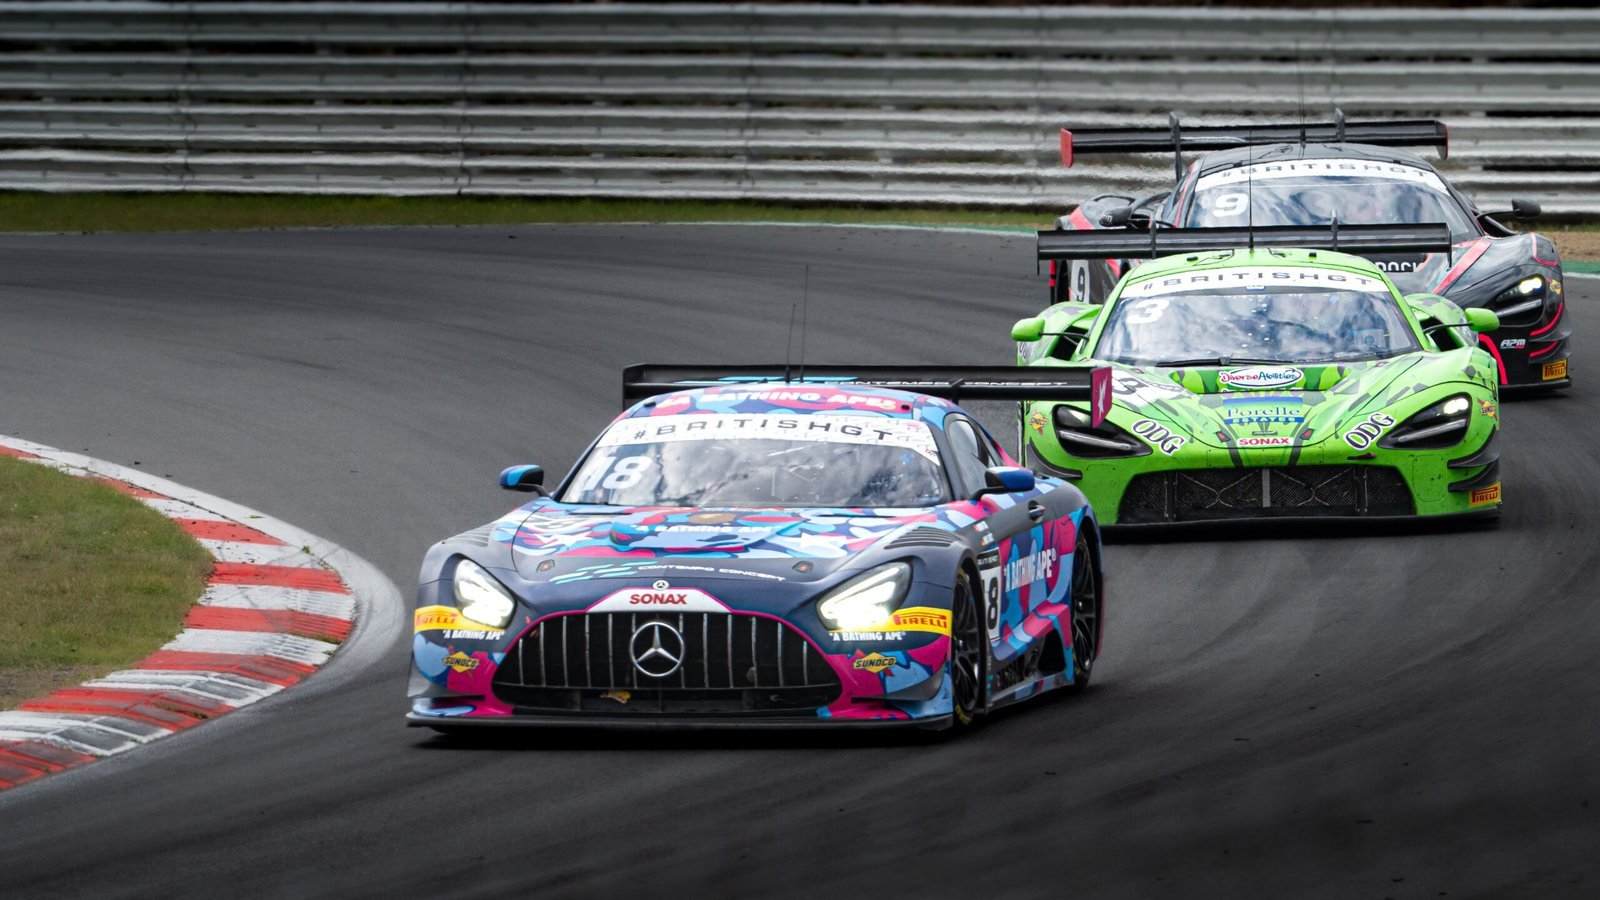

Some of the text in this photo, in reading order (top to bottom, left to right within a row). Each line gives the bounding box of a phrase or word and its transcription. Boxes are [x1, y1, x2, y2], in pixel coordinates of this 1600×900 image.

[1222, 162, 1428, 178] #BRITISHGT
[1212, 193, 1248, 217] 9
[1077, 266, 1086, 302] 9
[1143, 272, 1372, 291] #BRITISHGT
[1126, 299, 1169, 324] 3
[1226, 406, 1301, 418] Porelle
[633, 418, 893, 441] #BRITISHGT
[1133, 420, 1185, 454] ODG
[1344, 413, 1395, 449] ODG
[1238, 437, 1290, 446] SONAX
[580, 455, 653, 492] 18
[638, 564, 786, 582] CONTEMPO CONCEPT
[629, 593, 688, 606] SONAX
[980, 576, 999, 631] 8
[415, 611, 458, 628] PIRELLI
[893, 612, 948, 629] PIRELLI
[451, 630, 485, 640] BATHING
[842, 631, 882, 642] BATHING
[444, 655, 479, 669] SUNOCO
[854, 657, 897, 669] SUNOCO
